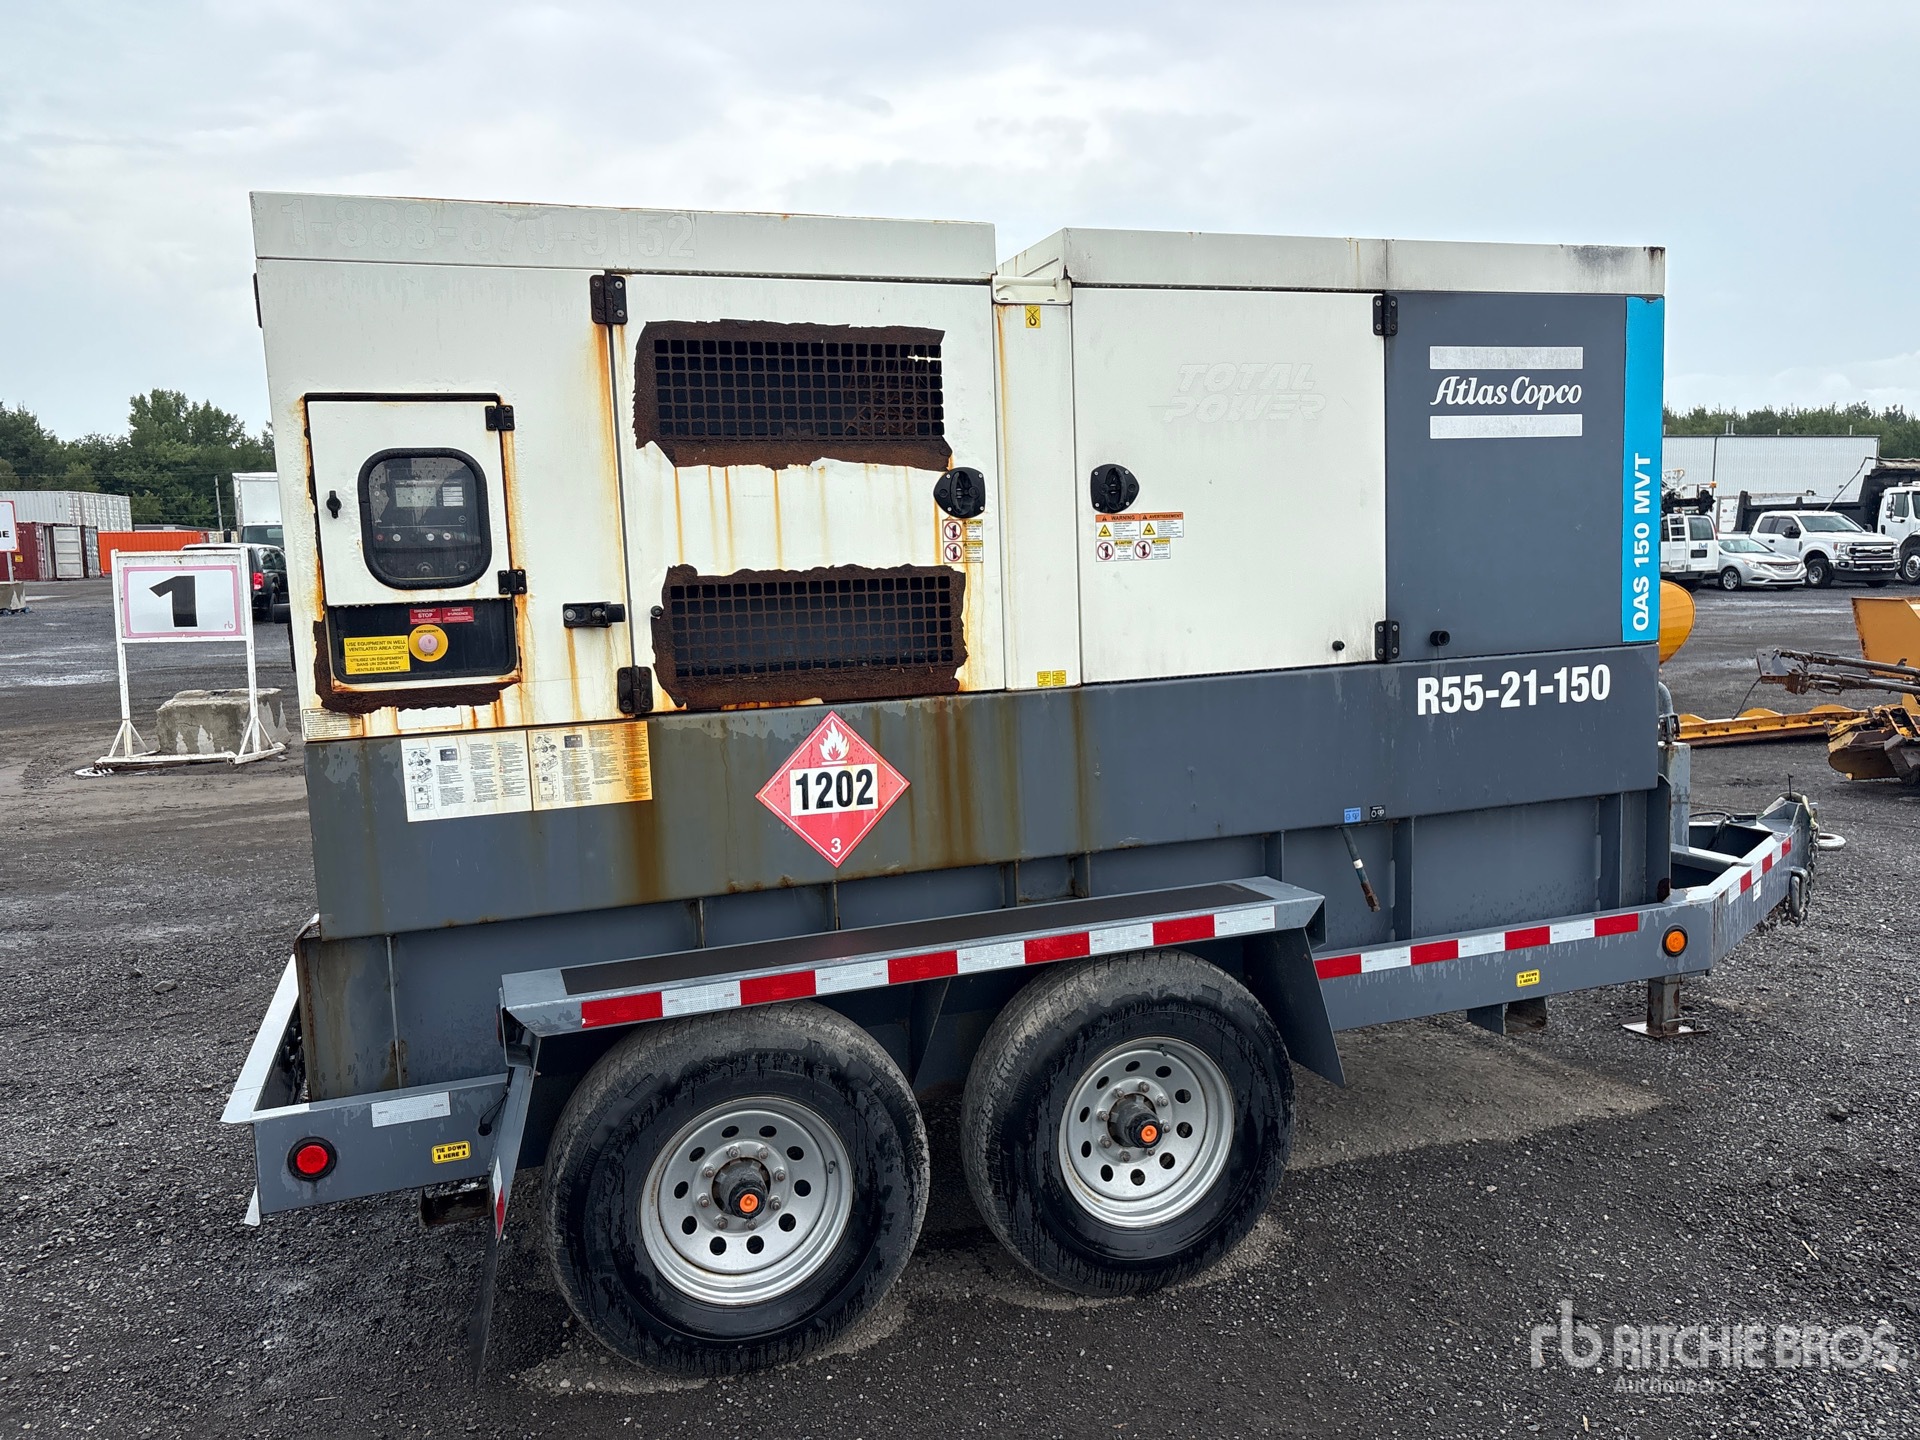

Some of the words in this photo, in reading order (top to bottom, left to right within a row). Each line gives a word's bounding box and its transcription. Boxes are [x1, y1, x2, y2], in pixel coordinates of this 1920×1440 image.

[281, 198, 696, 259] 1-888-870-9152
[1177, 362, 1316, 392] TOTAL
[1430, 376, 1508, 405] Atlas
[1511, 376, 1582, 410] Copco
[1162, 393, 1327, 423] POWER
[1634, 453, 1651, 514] MVT
[0, 530, 10, 538] E
[1634, 523, 1650, 567] 150
[149, 576, 198, 627] 1
[1633, 576, 1650, 631] QAS
[224, 620, 234, 629] rb
[1417, 664, 1611, 716] R55-21-150
[795, 768, 874, 810] 1202
[830, 838, 842, 853] 3
